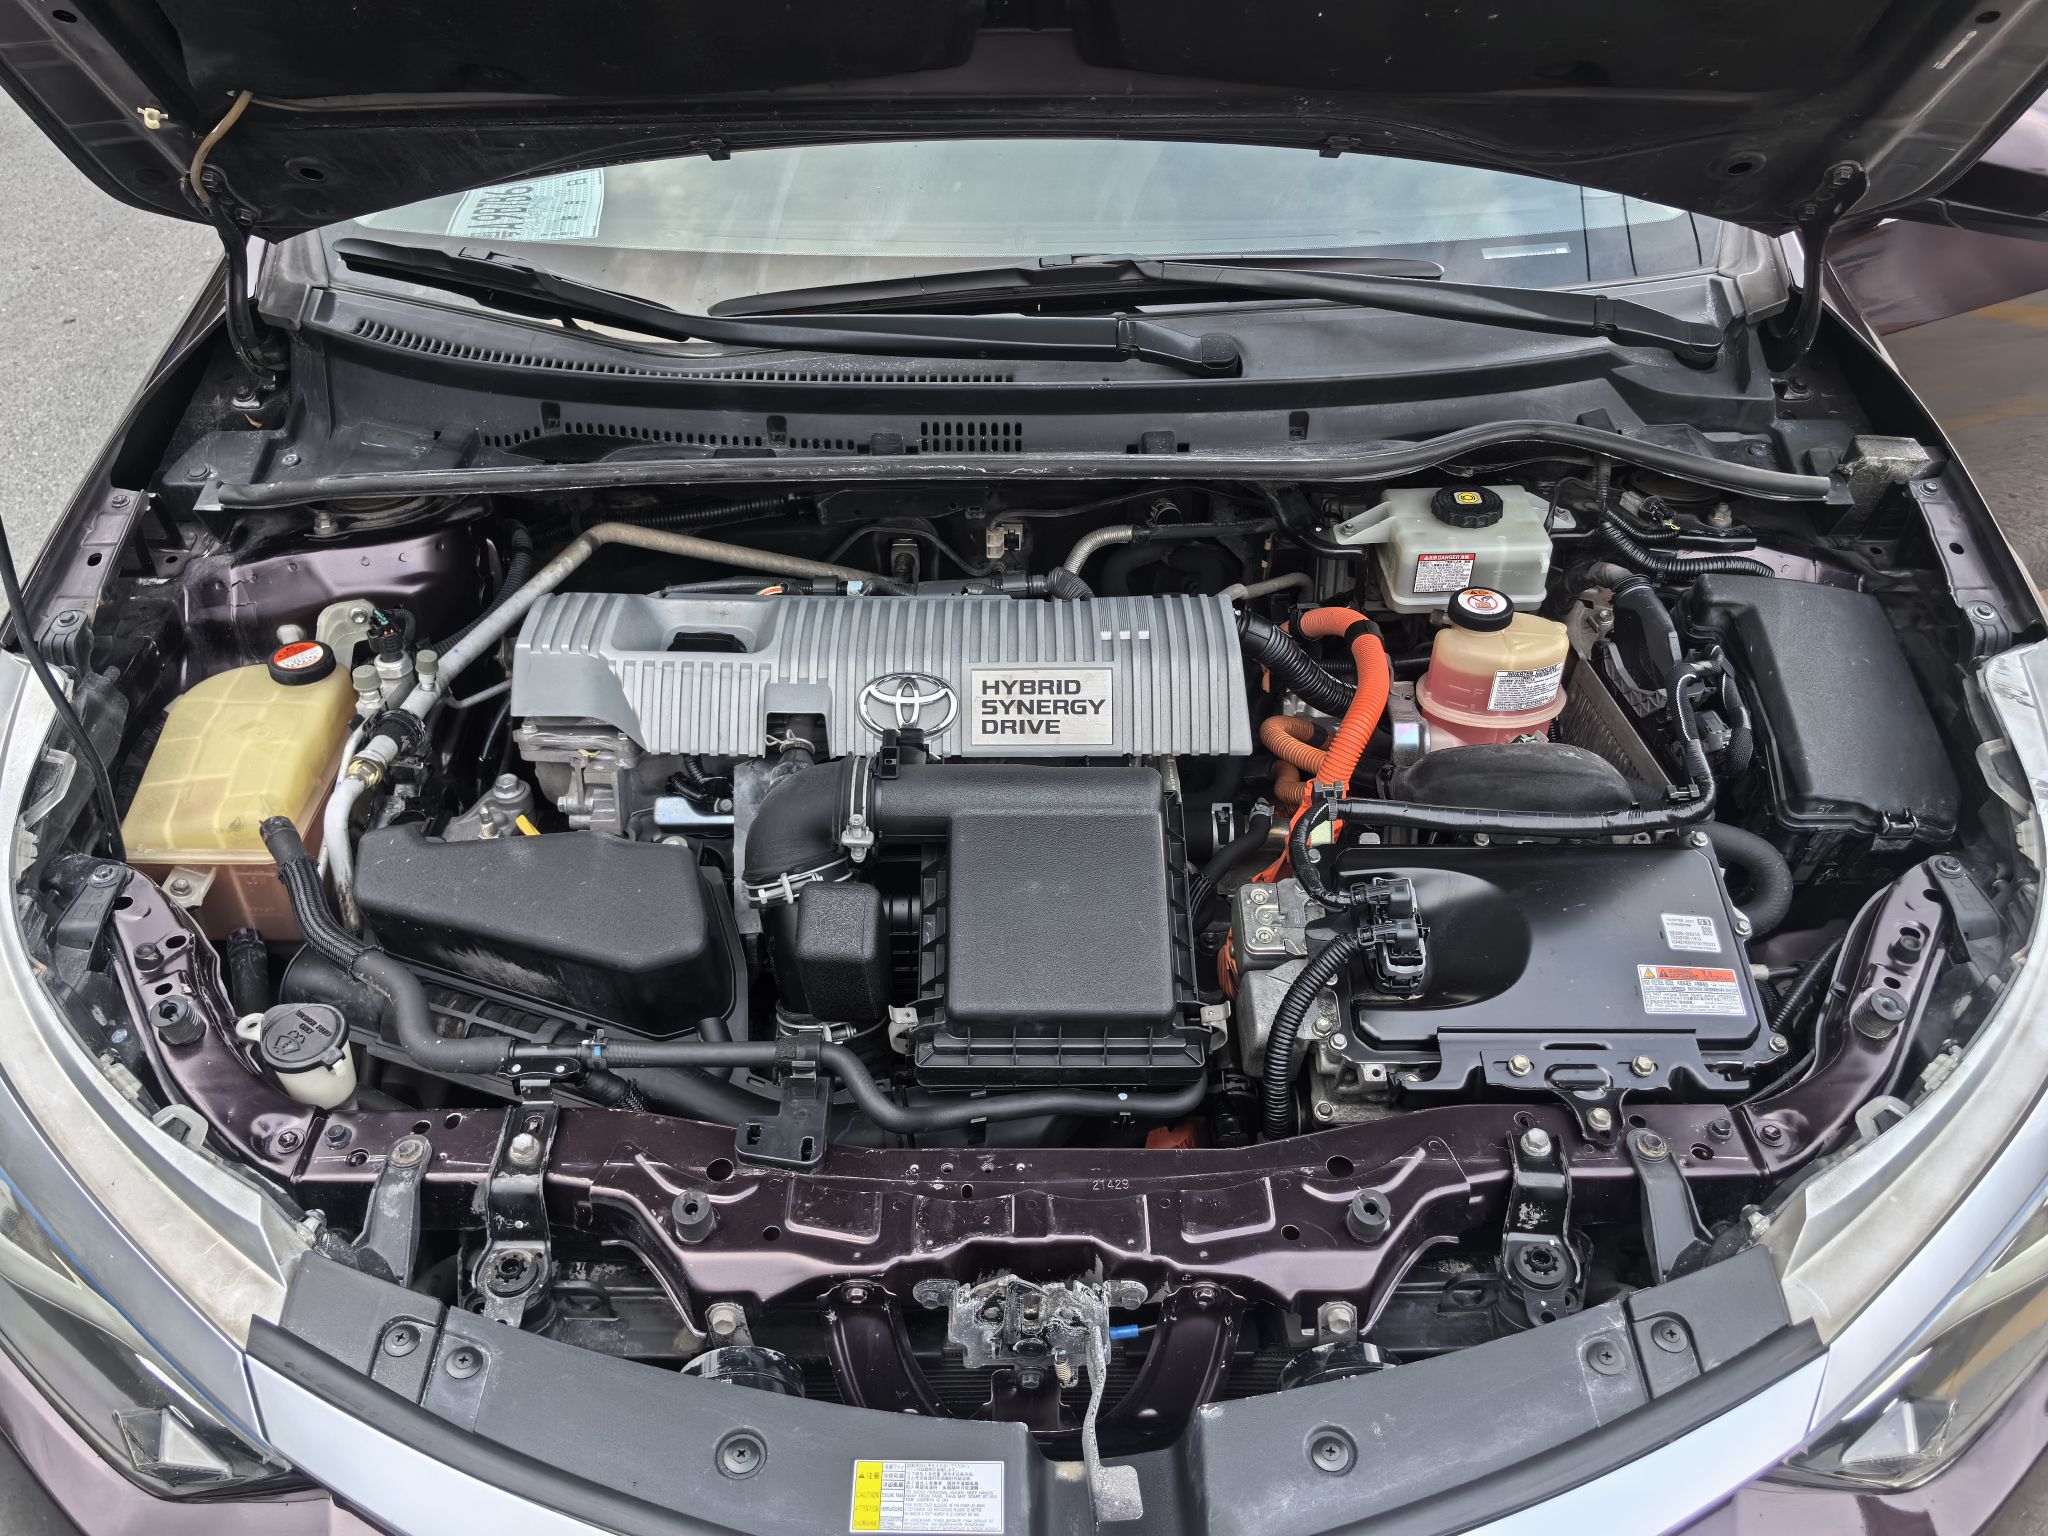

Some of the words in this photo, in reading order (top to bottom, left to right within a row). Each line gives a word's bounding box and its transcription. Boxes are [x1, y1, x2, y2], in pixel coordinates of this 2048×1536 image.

[981, 680, 1081, 695] HYBRID
[981, 699, 1106, 715] SYNERGY
[981, 719, 1061, 735] DRIVE
